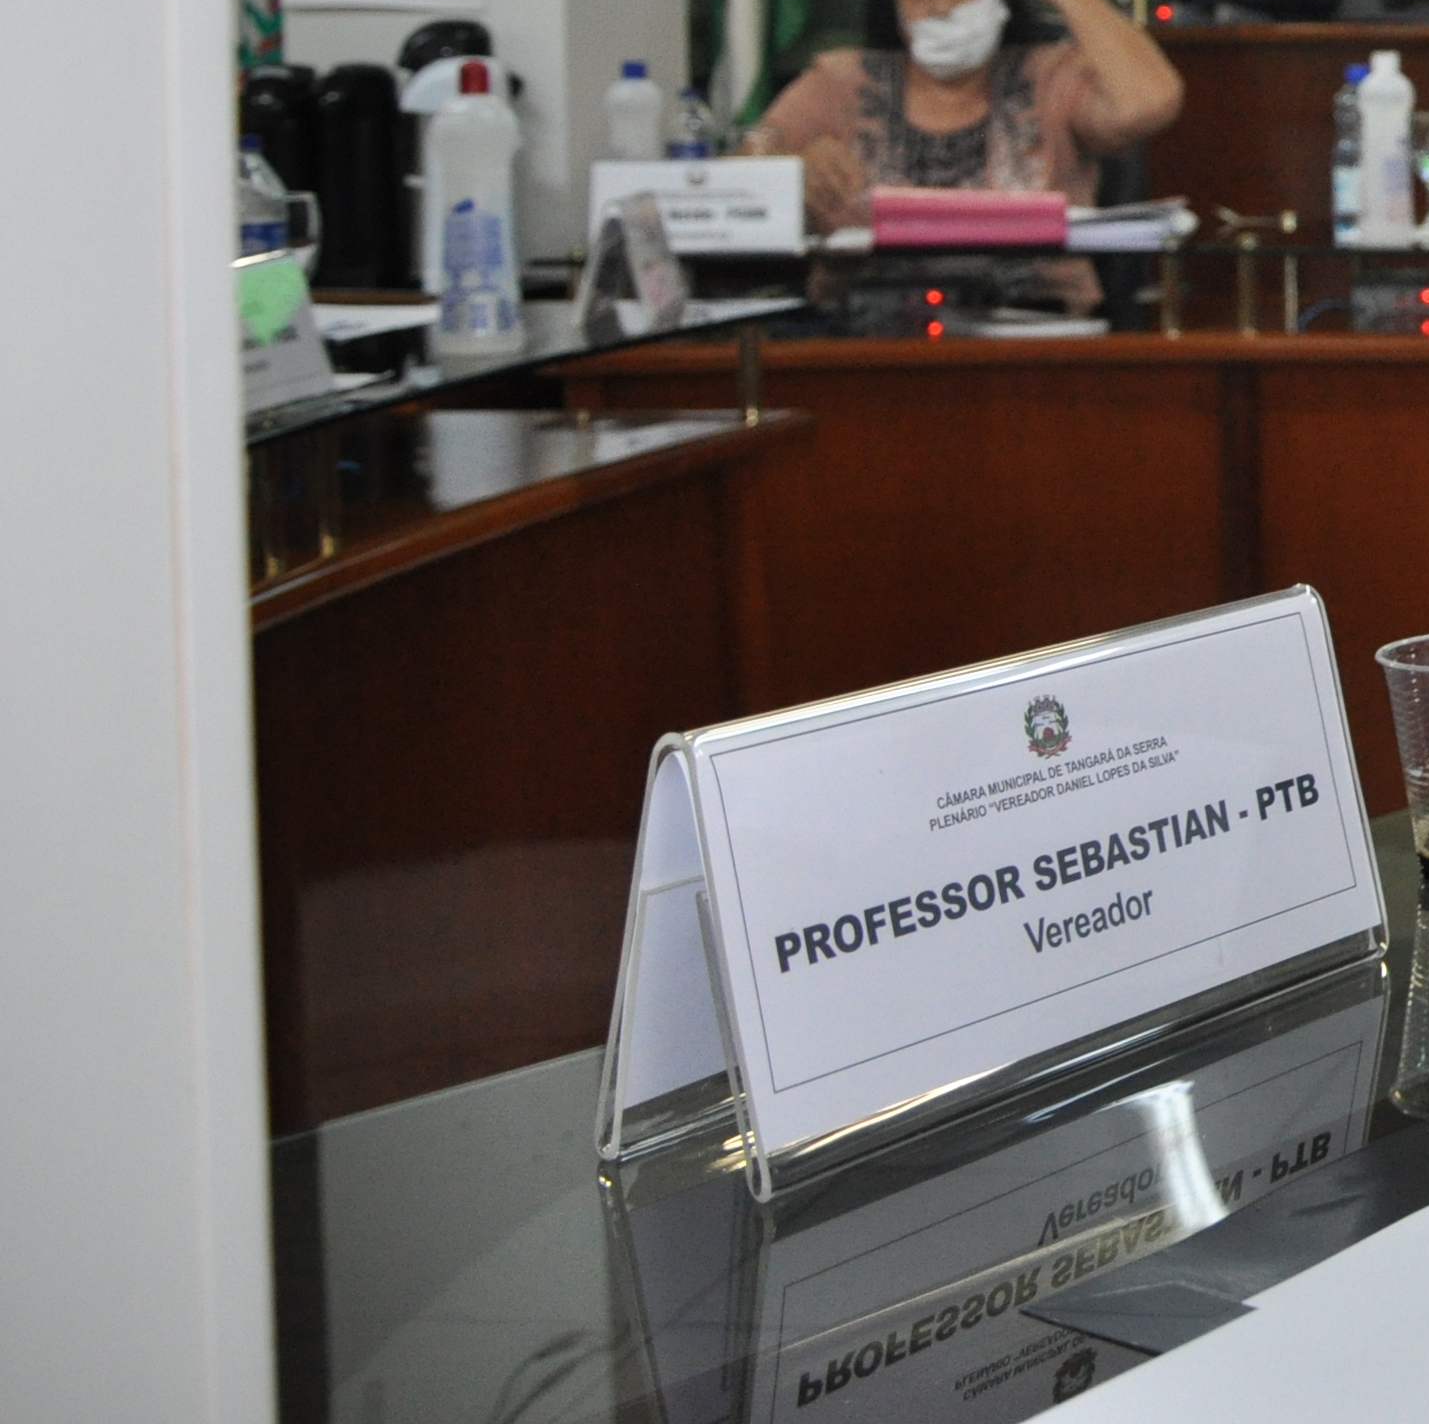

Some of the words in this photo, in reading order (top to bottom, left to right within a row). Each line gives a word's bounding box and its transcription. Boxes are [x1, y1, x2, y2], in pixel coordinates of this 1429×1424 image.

[929, 803, 987, 832] PLENÁRIO
[1056, 776, 1095, 798] DANIEL
[1096, 764, 1130, 784] LOPES
[1131, 760, 1148, 774] DA
[936, 786, 987, 809] CÂMARA
[988, 770, 1047, 795] MUNICIPAL
[1047, 765, 1063, 780] DE
[1065, 747, 1115, 773] TANGARÁ
[1116, 745, 1132, 760] DA
[1132, 735, 1168, 756] SERRA
[775, 865, 1025, 973] PROFESSOR
[1032, 799, 1230, 892] SEBASTIAN
[1238, 808, 1250, 819] -
[1255, 773, 1321, 821] PTB
[1023, 888, 1155, 954] Vereador
